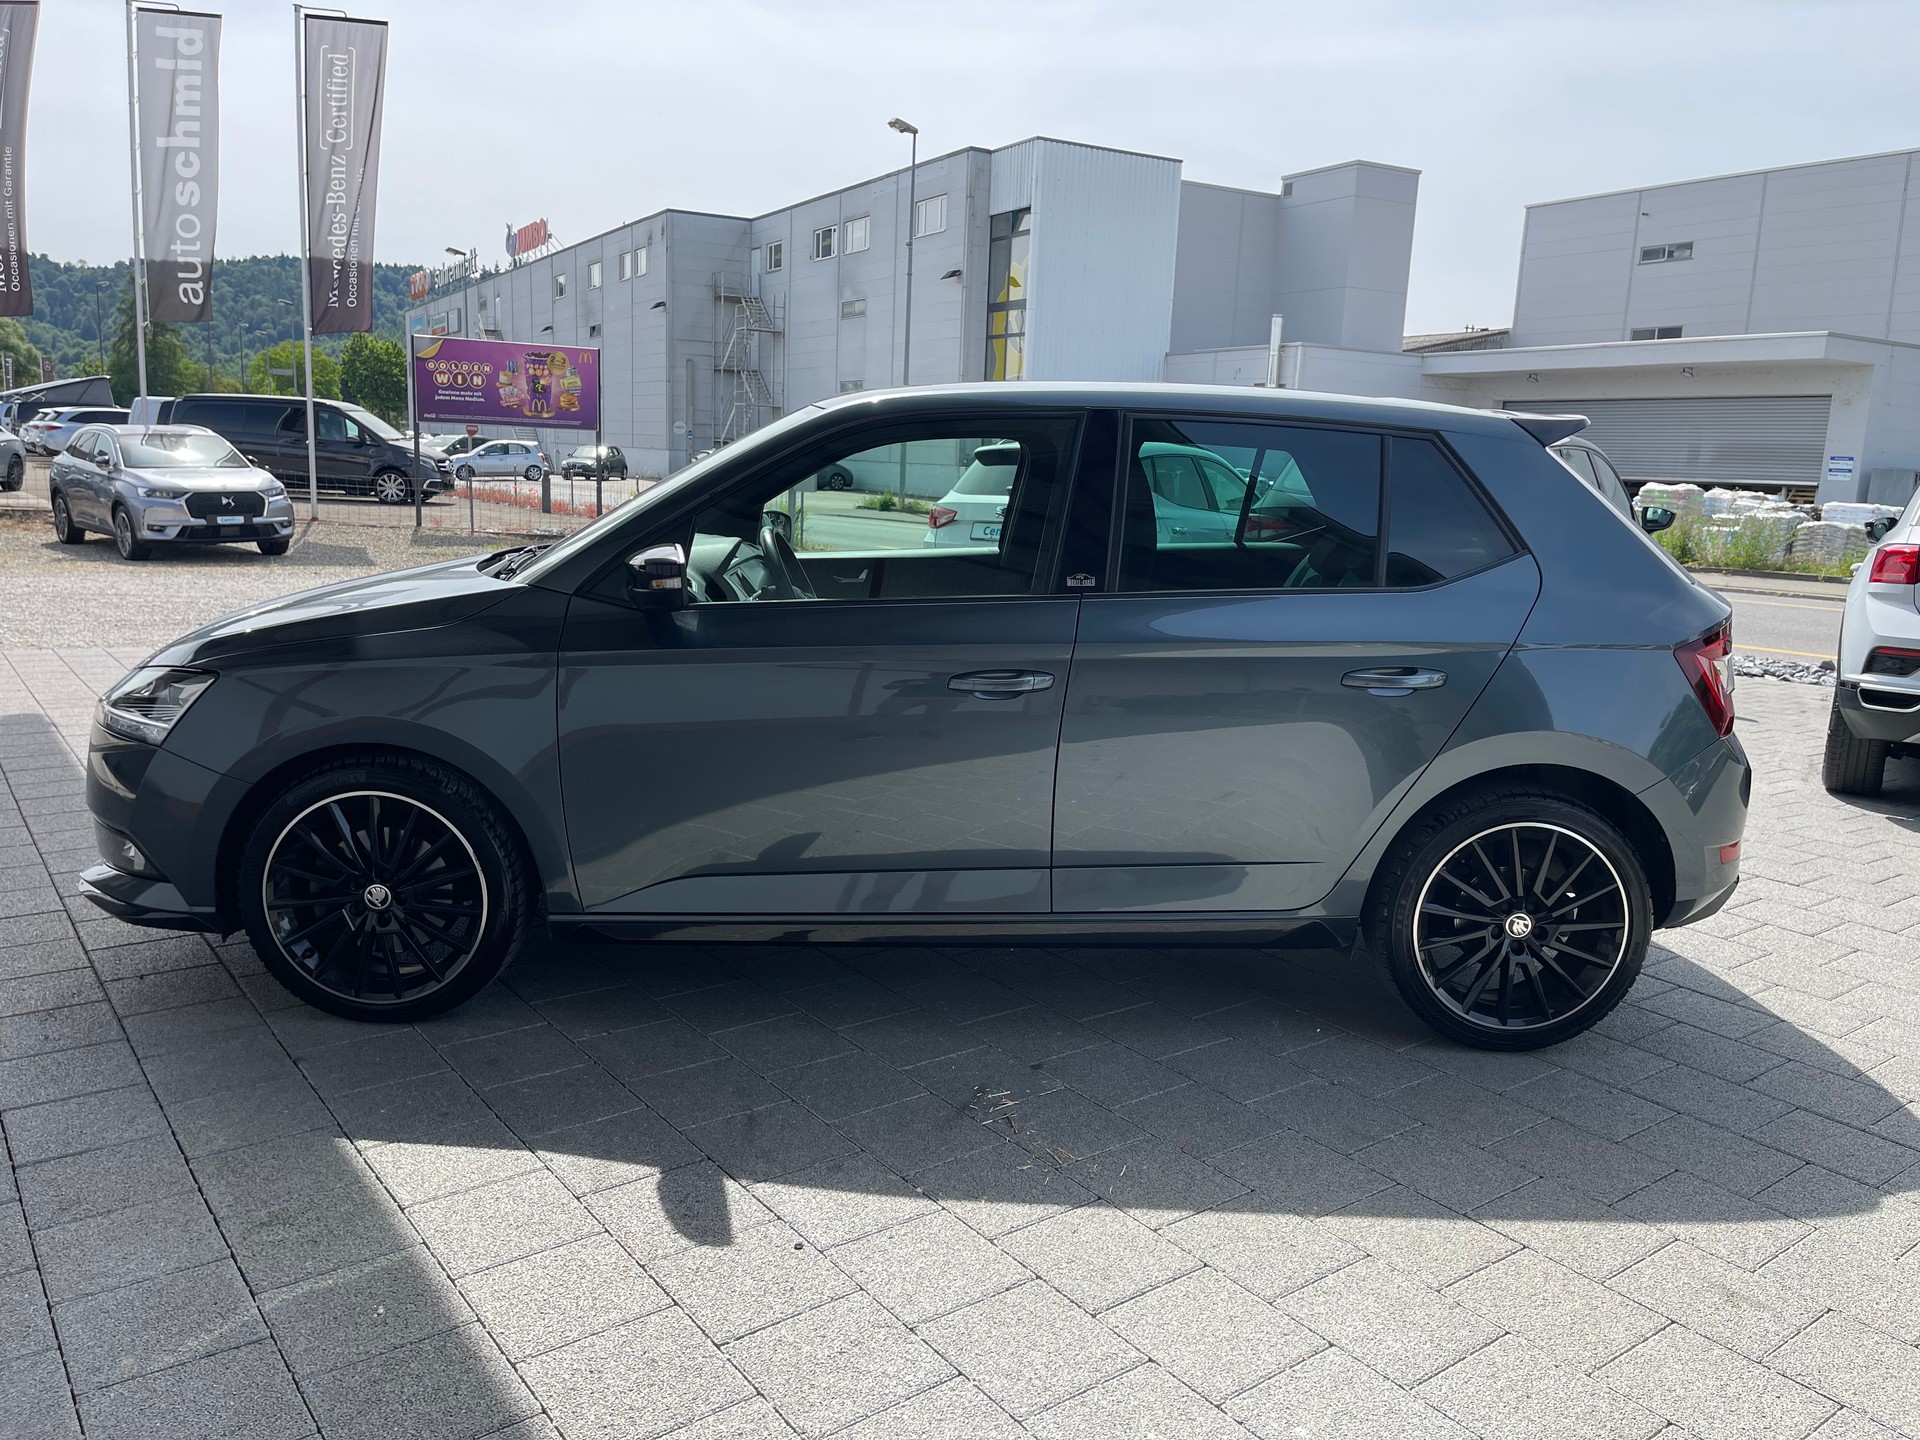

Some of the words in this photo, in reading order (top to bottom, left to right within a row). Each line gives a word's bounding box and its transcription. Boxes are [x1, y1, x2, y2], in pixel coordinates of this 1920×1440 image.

[325, 53, 350, 144] Certified
[4, 146, 13, 197] Garantie
[5, 200, 14, 219] mit
[326, 154, 348, 309] Mercedes-Benz
[8, 222, 21, 292] Occasionen
[516, 217, 547, 256] JUMBO
[347, 241, 359, 308] Occasionen
[427, 361, 491, 373] GOLDEN
[435, 373, 483, 386] WIN
